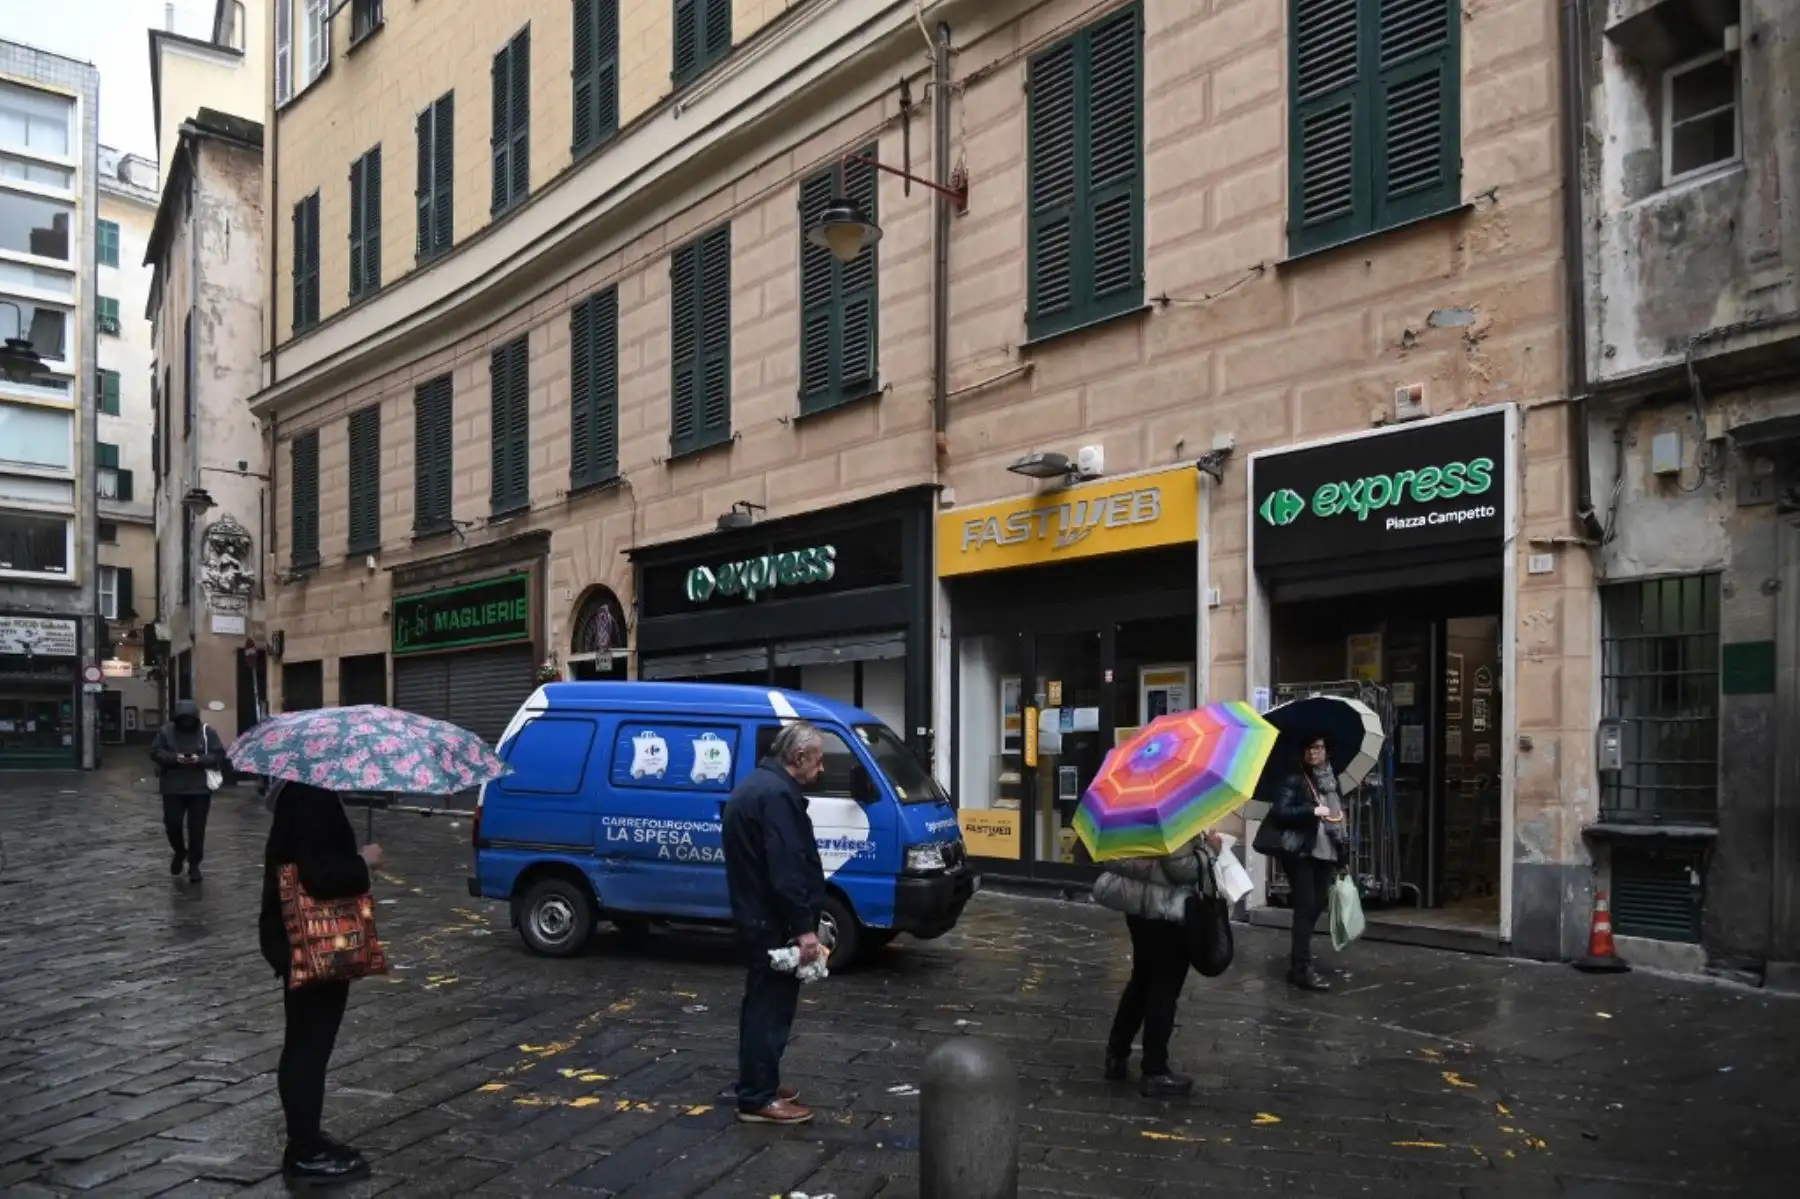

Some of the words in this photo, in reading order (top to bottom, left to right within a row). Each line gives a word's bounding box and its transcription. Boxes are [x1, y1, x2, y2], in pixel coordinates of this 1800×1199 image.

[1312, 458, 1494, 521] express
[961, 487, 1161, 552] FASTWEB
[1385, 514, 1427, 530] Piazza
[1428, 506, 1496, 526] Campetto
[716, 544, 836, 602] express
[434, 597, 526, 632] MAGLIERIE
[602, 816, 723, 833] CARREFOURGONCIN
[607, 827, 624, 842] LA
[634, 828, 693, 846] SPESA
[658, 845, 671, 860] A
[675, 845, 726, 862] CASA
[815, 834, 877, 851] ervices
